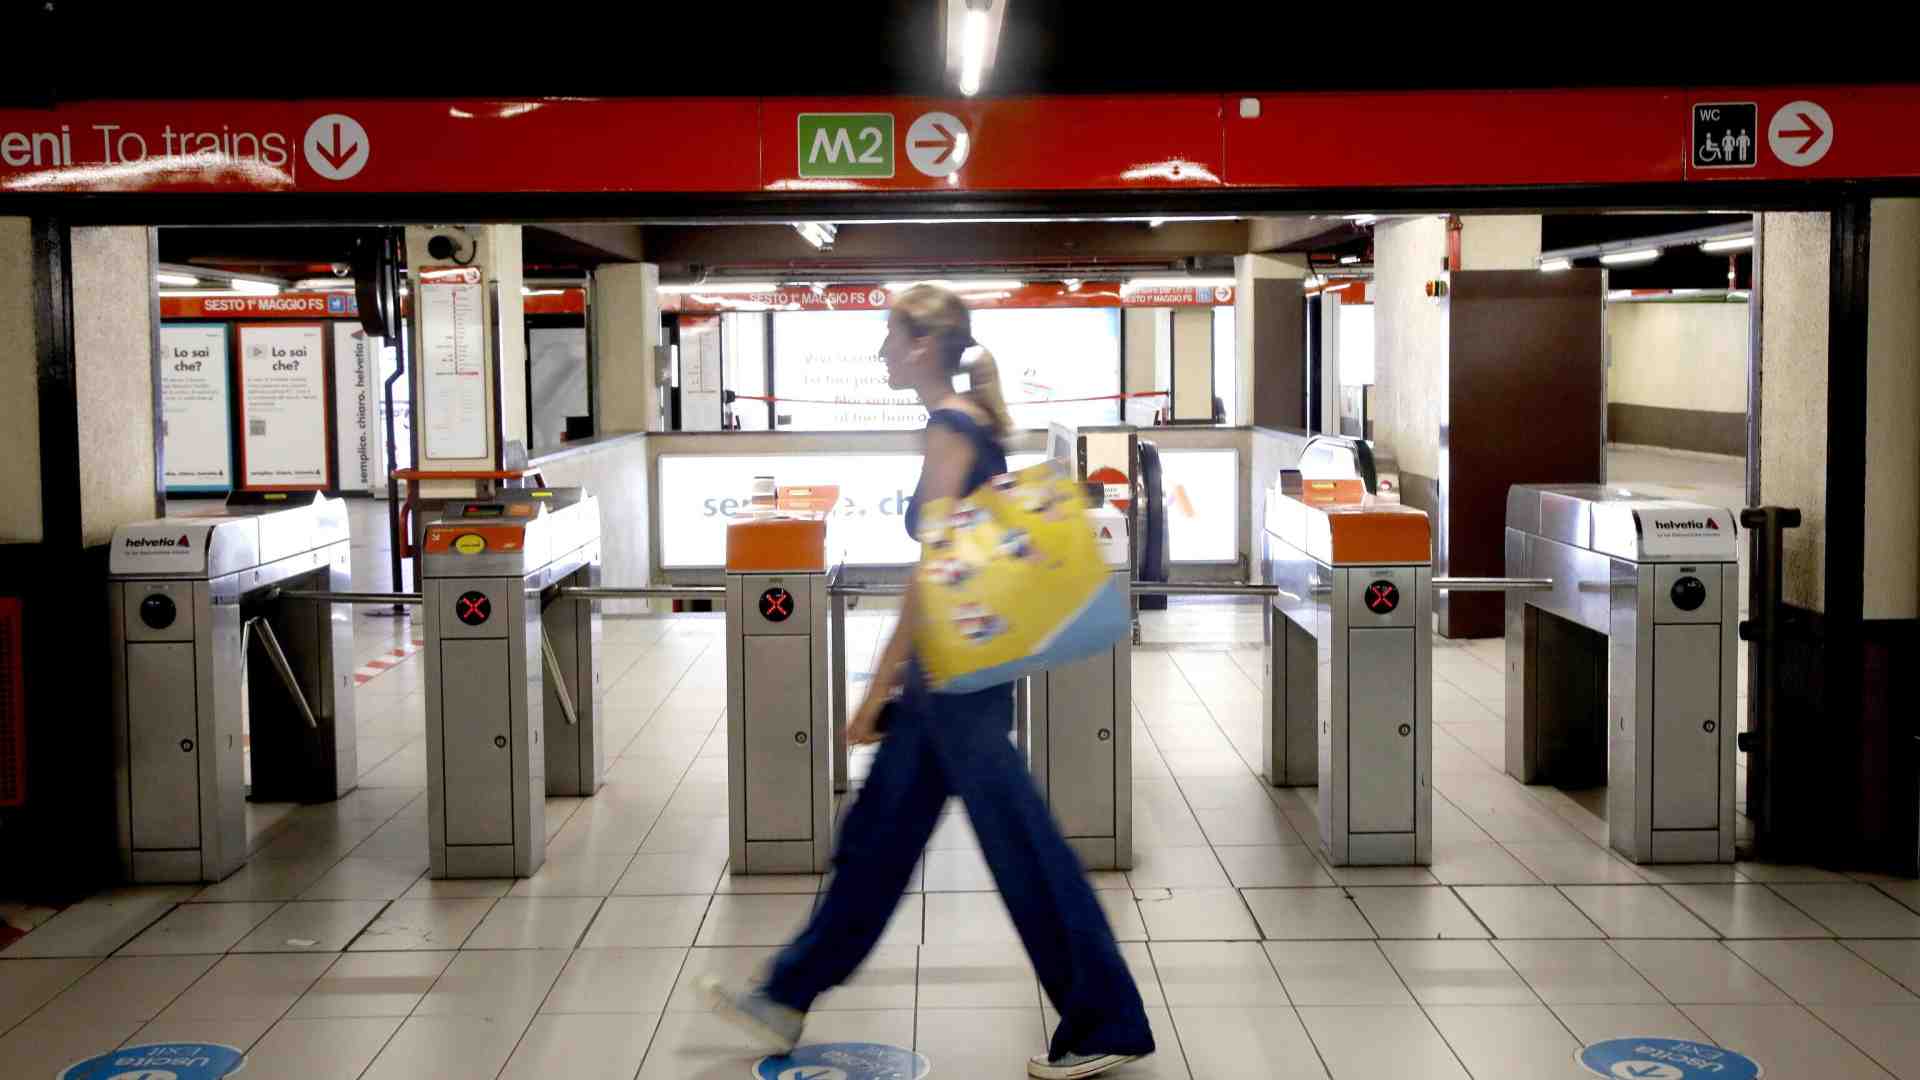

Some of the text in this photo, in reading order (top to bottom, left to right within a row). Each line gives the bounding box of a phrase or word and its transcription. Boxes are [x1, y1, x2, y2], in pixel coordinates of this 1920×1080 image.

[1700, 108, 1720, 121] WC
[92, 124, 147, 166] To
[161, 124, 288, 167] trains
[808, 127, 884, 164] M2
[801, 292, 848, 304] MAGGIO
[850, 292, 865, 304] FS
[205, 298, 245, 311] SESTO
[258, 298, 306, 311] MAGGIO
[308, 298, 324, 310] FS
[174, 347, 210, 358] Lo sai
[272, 346, 308, 358] Lo sai
[174, 361, 202, 371] che?
[272, 360, 300, 371] che?
[355, 343, 370, 483] semplice. chiaro. helvetia
[1655, 520, 1704, 529] helvetia
[126, 537, 175, 547] helvetia
